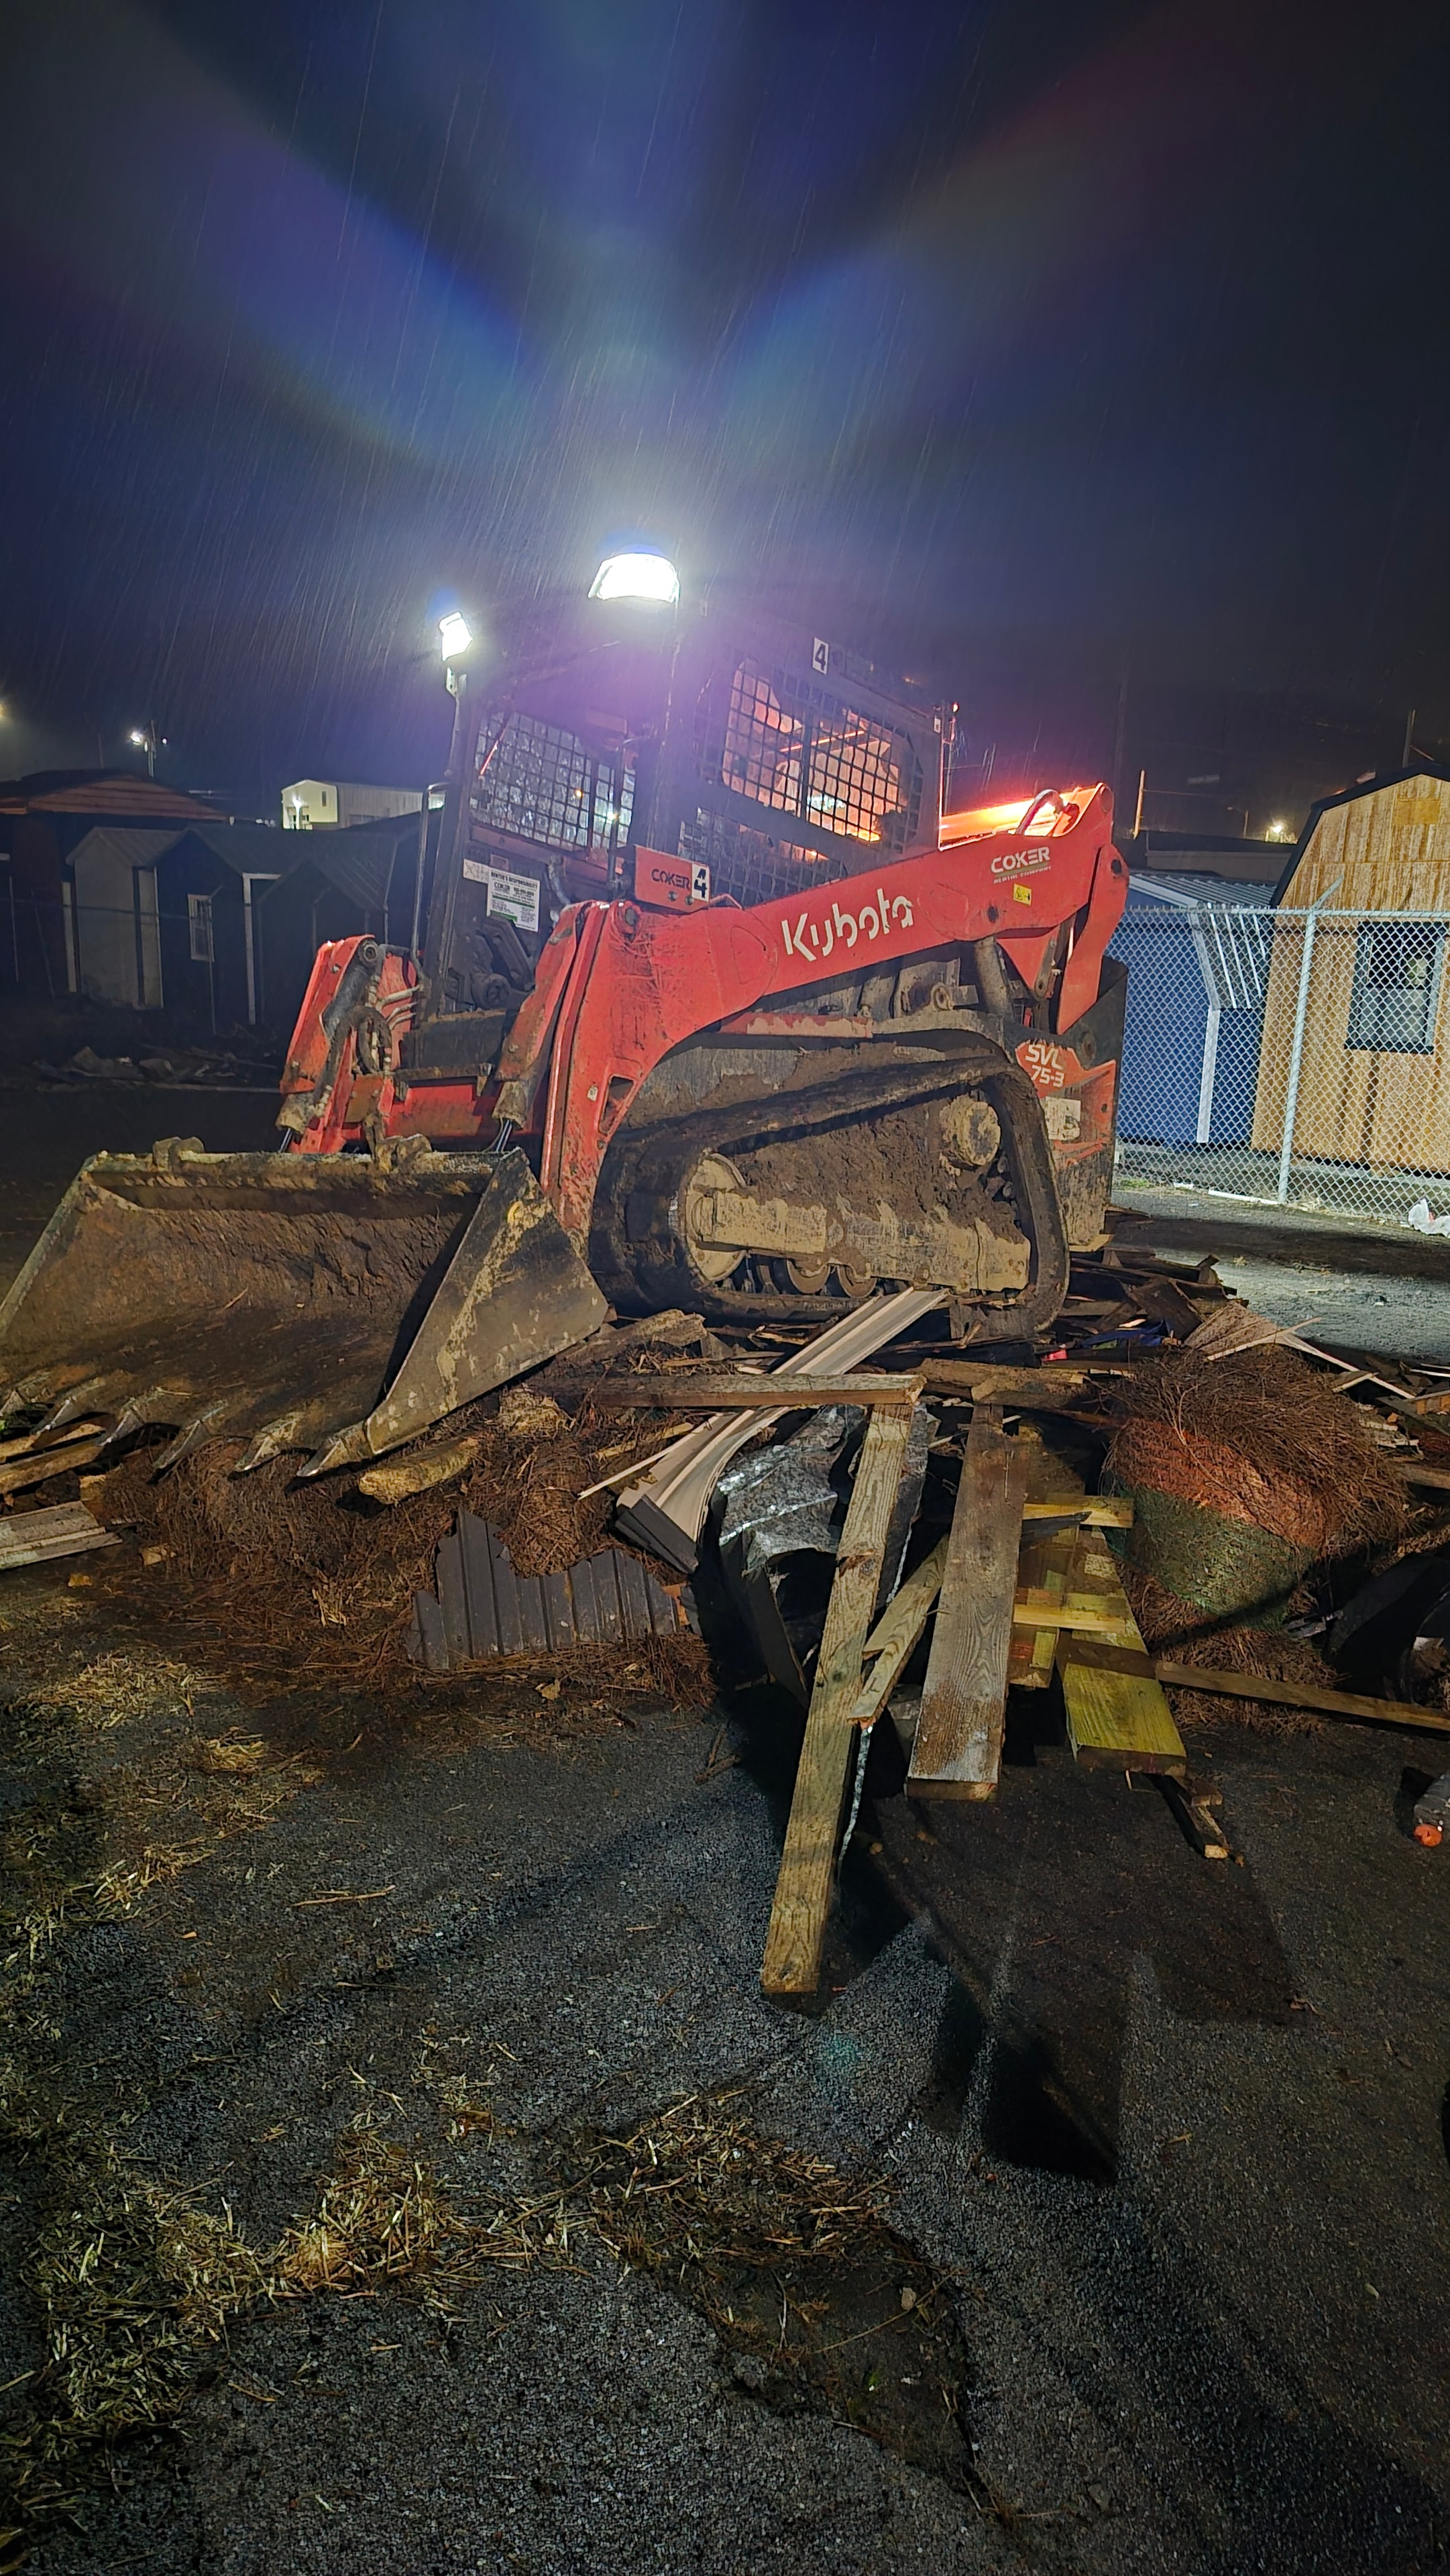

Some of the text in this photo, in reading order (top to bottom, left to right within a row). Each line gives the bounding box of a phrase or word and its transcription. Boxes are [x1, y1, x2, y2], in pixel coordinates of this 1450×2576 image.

[815, 643, 826, 672] 4
[991, 847, 1050, 873] COKER
[1020, 865, 1052, 877] COMPANY
[651, 868, 690, 891] COKER
[693, 868, 708, 898] 4
[781, 888, 913, 962] Kubota
[1025, 1044, 1064, 1070] SVL
[1031, 1065, 1064, 1087] 75-3
